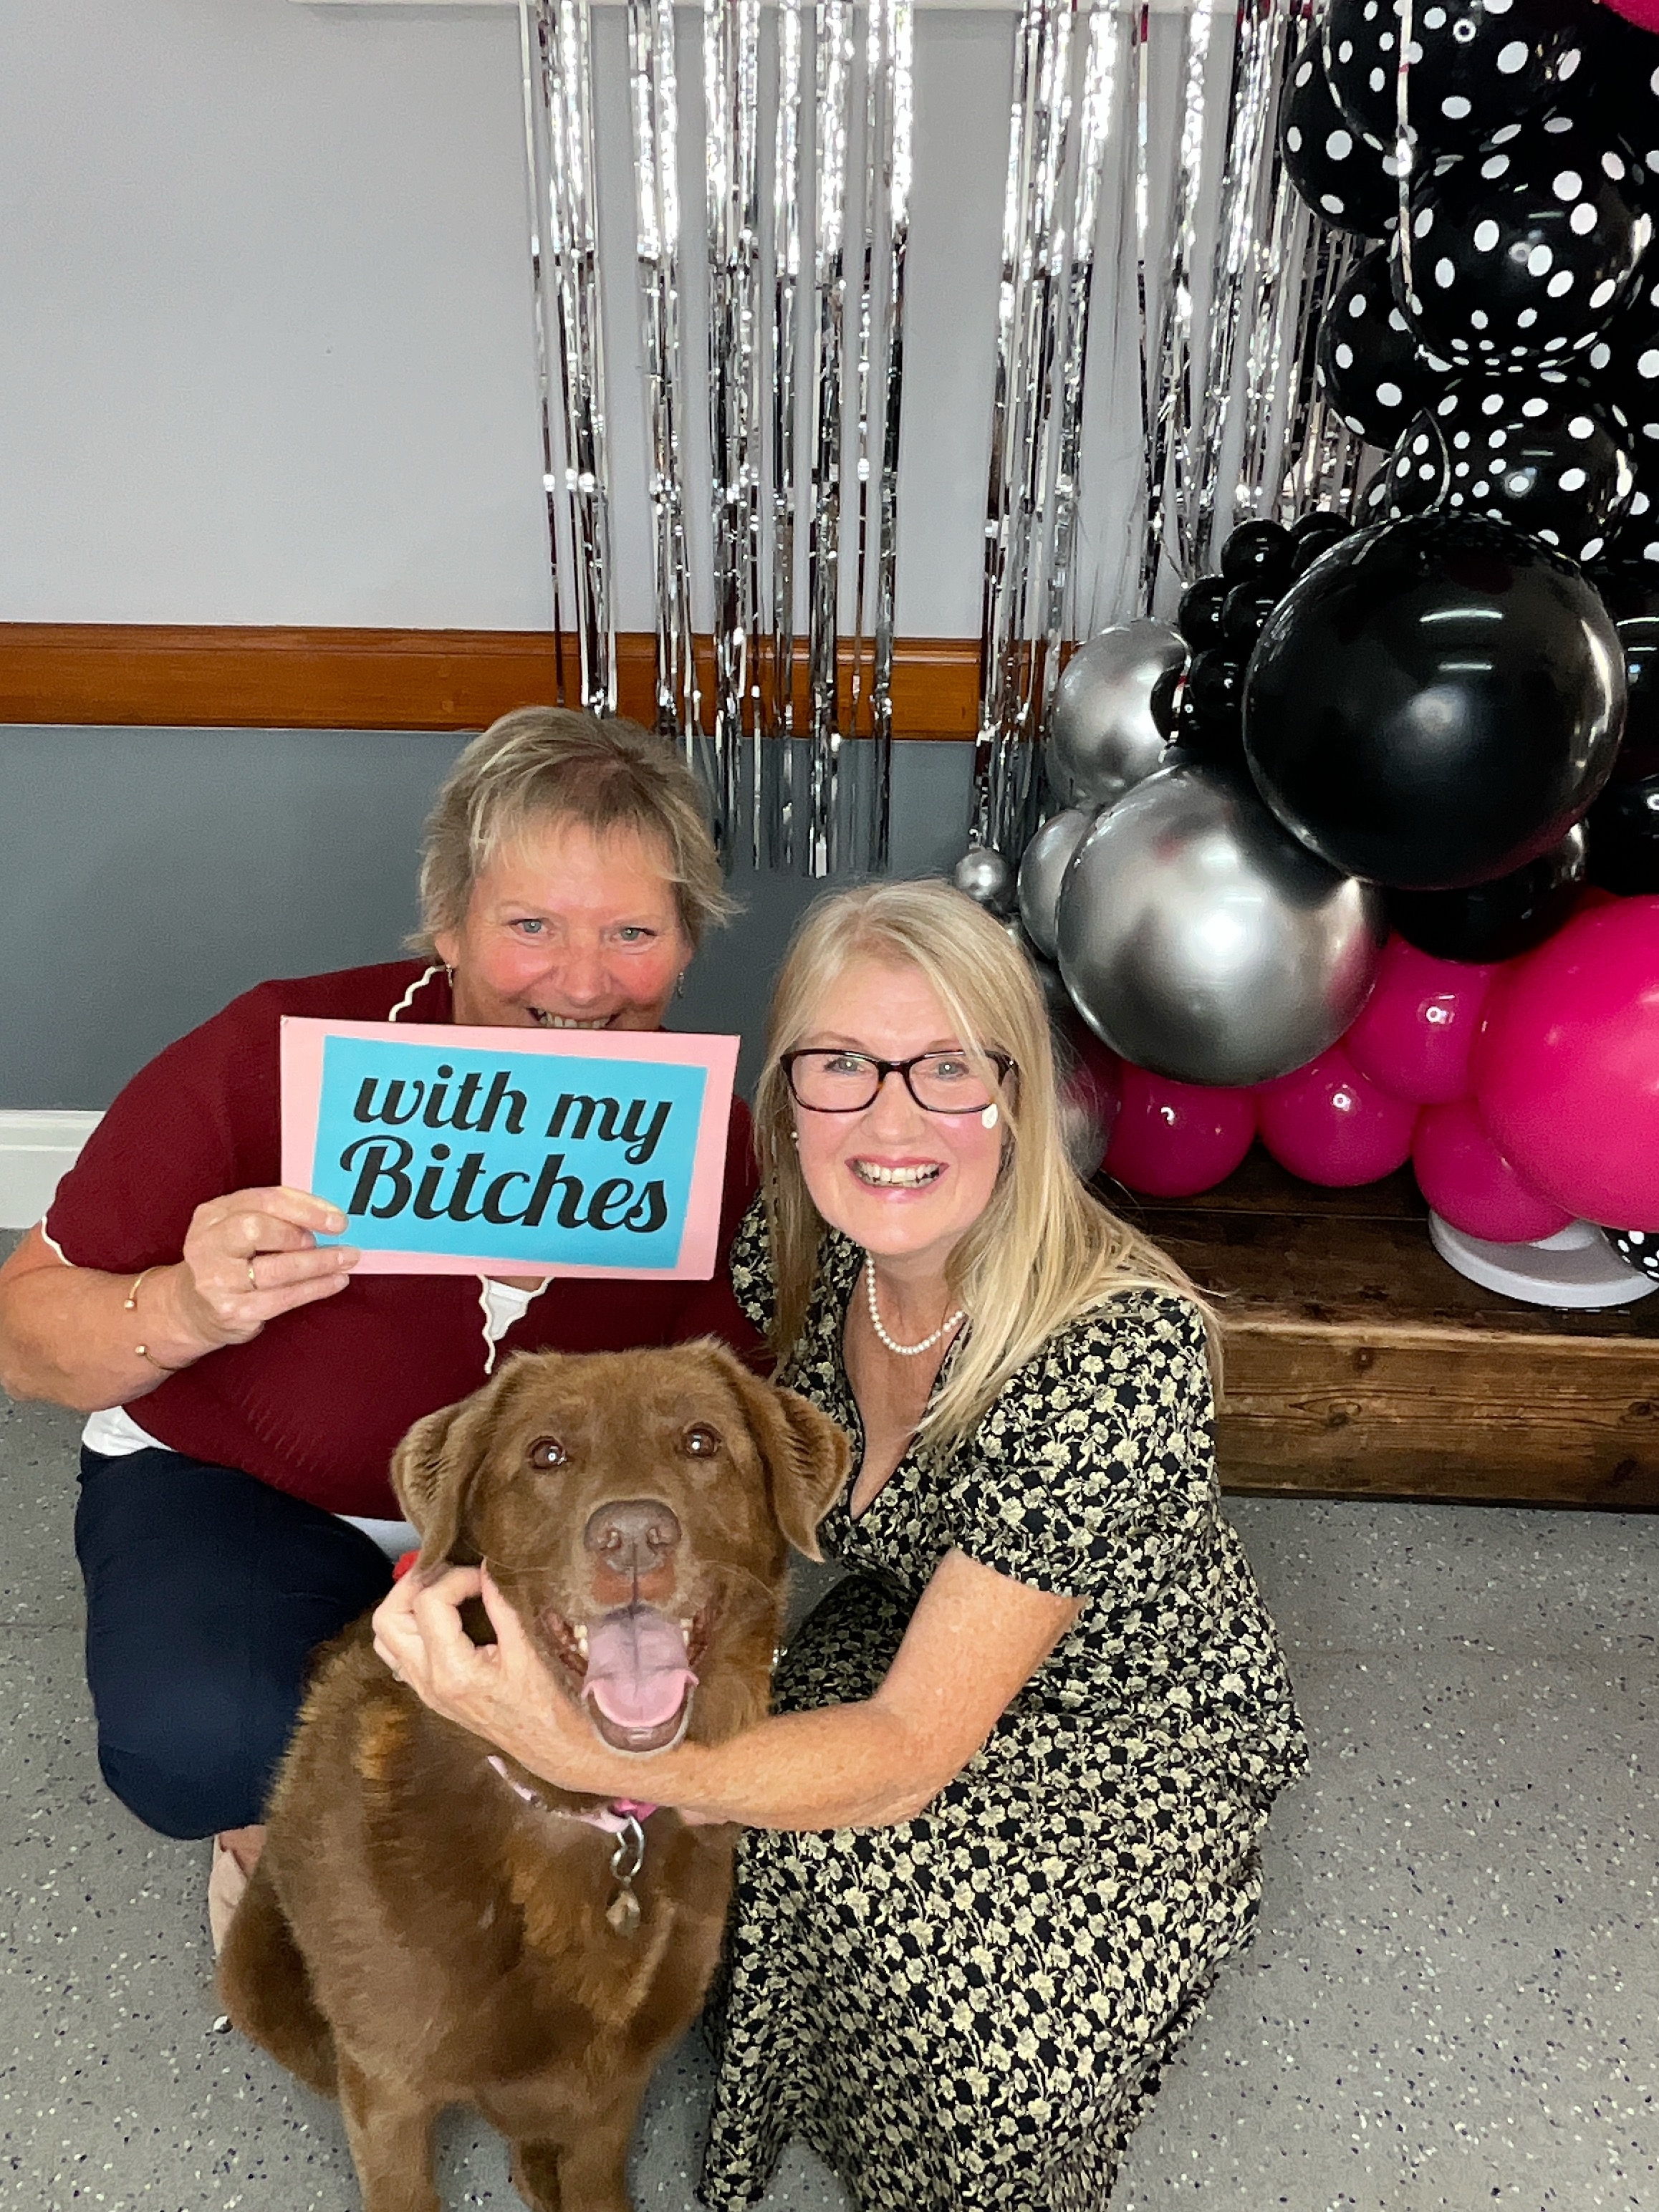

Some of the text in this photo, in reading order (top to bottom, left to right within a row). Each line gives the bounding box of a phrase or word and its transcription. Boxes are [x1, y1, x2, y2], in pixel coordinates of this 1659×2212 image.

[354, 1064, 673, 1165] with my
[340, 1135, 668, 1234] Bitches
